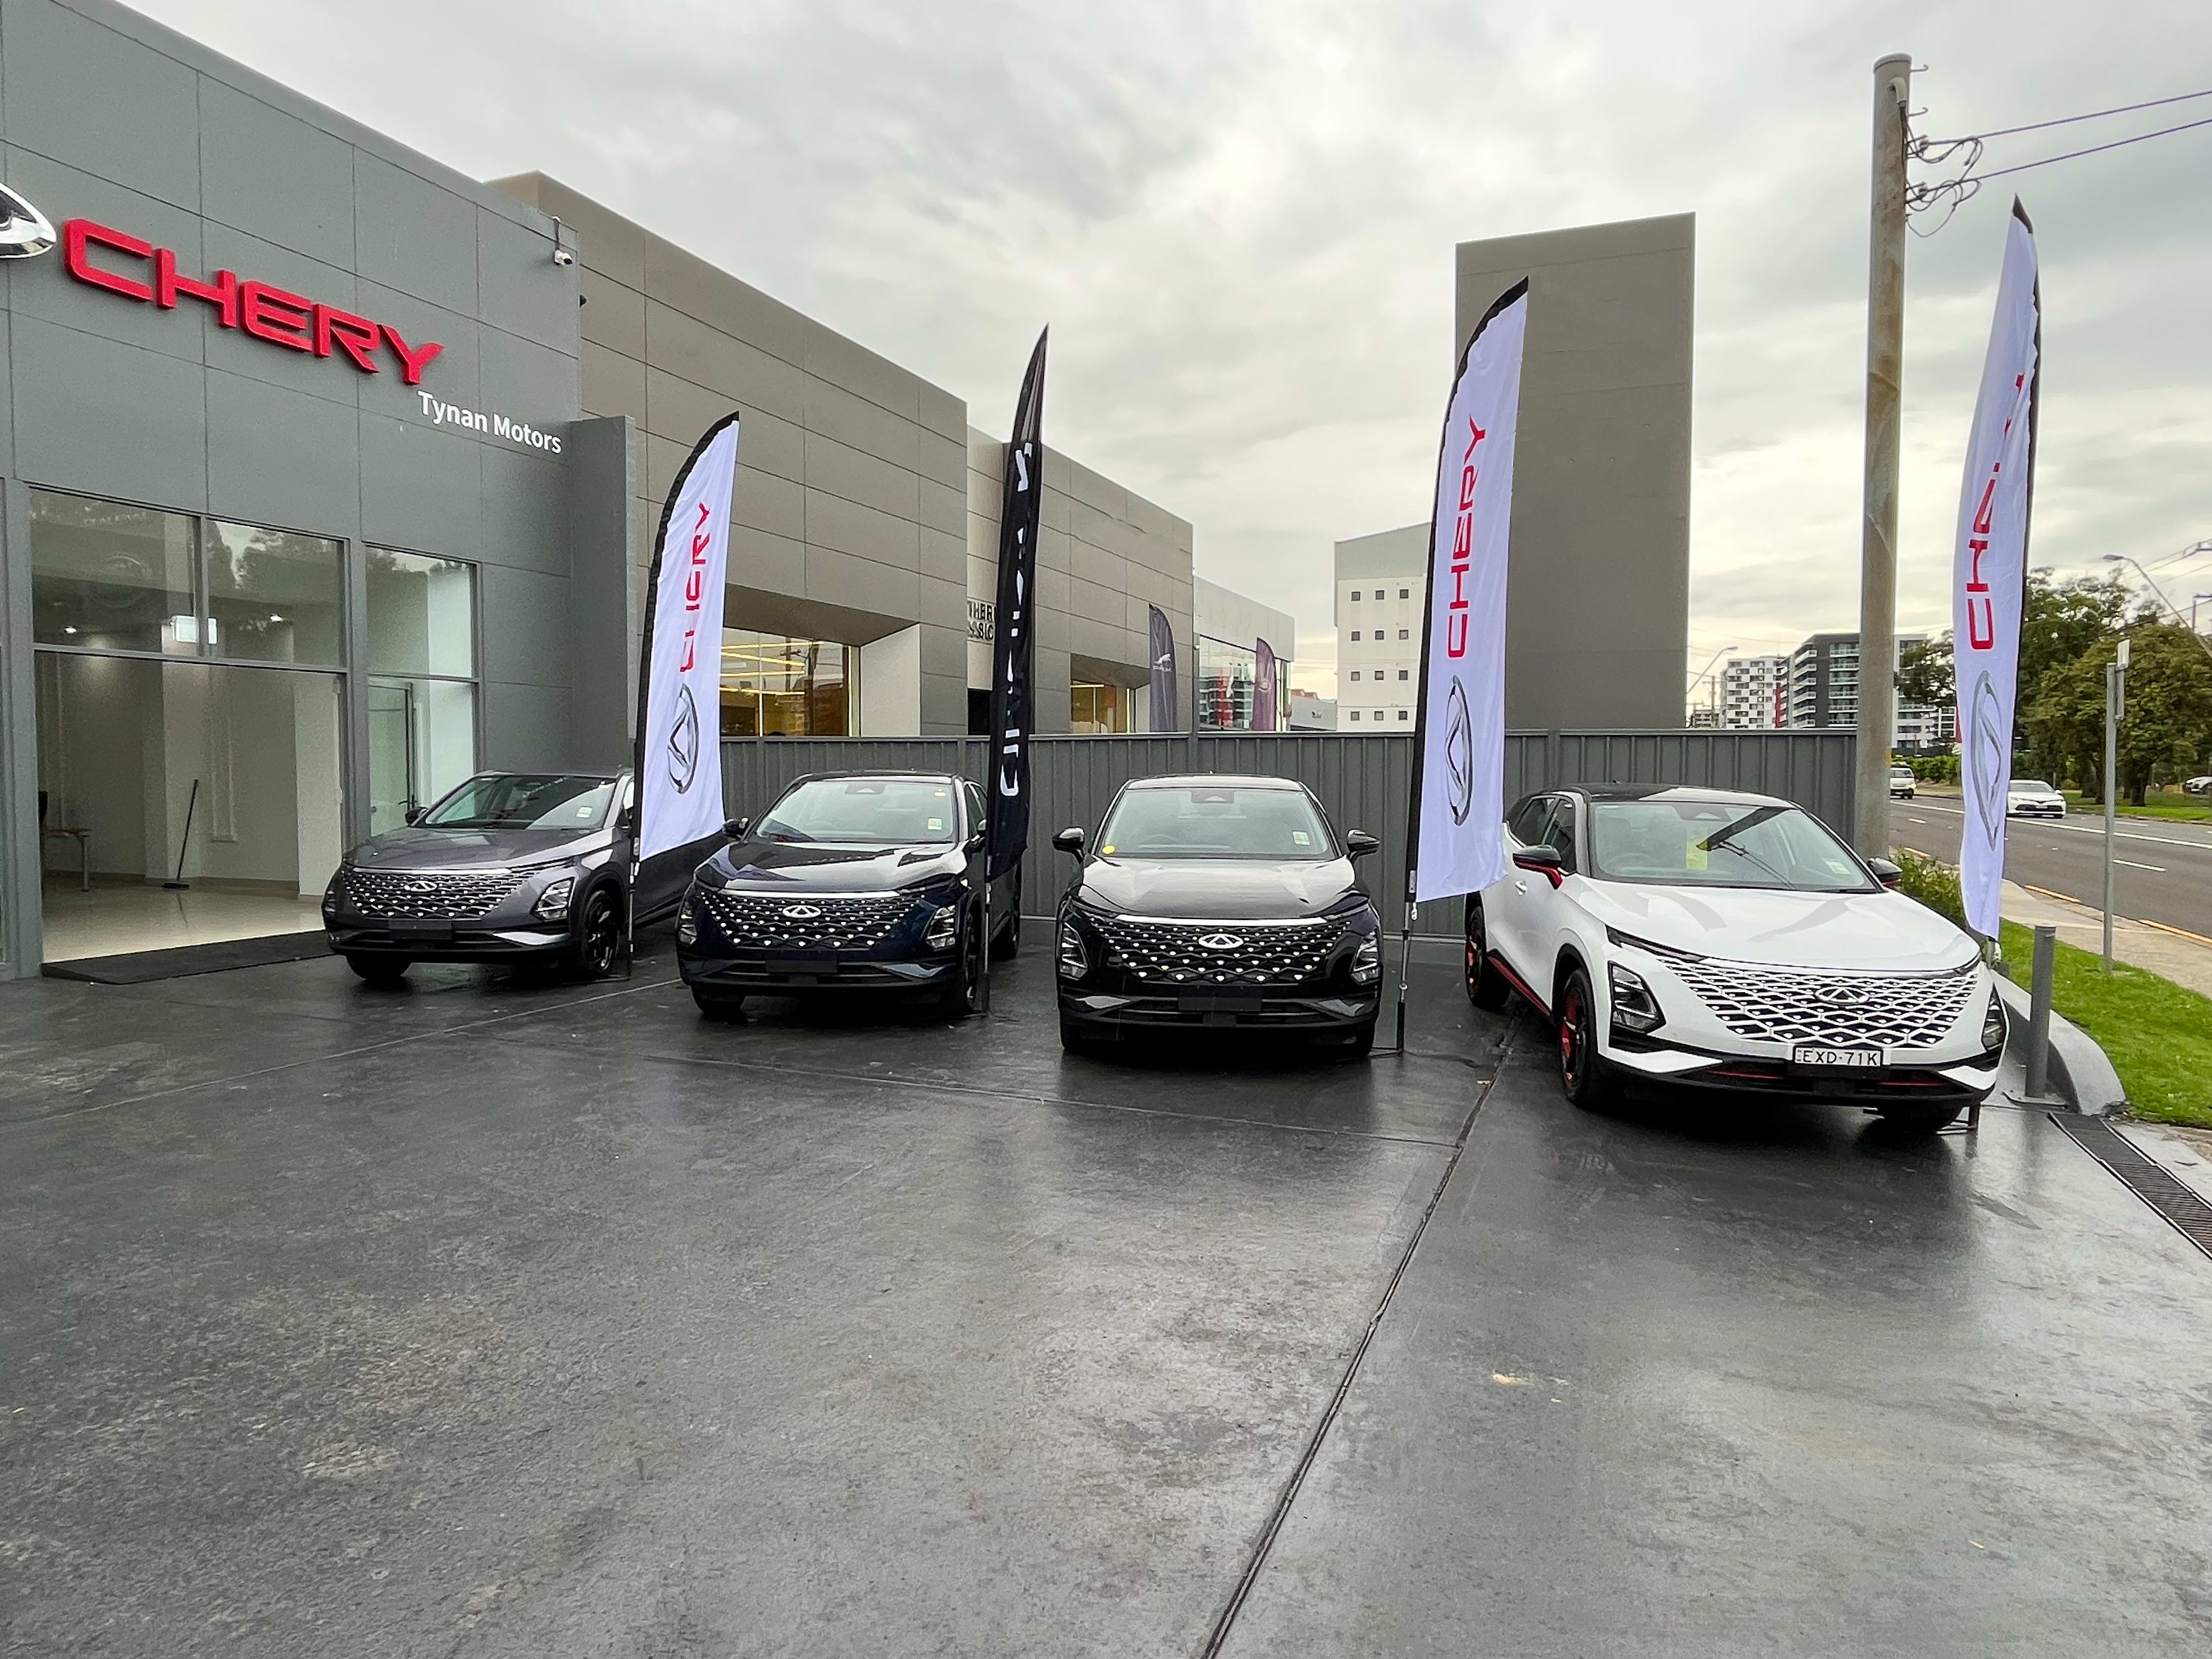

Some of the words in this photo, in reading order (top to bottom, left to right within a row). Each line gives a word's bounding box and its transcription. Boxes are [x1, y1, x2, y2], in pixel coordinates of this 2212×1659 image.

[63, 218, 444, 385] CHERY
[417, 390, 488, 433] Tynan
[493, 413, 562, 454] Motors
[1448, 414, 1486, 658] CHERY
